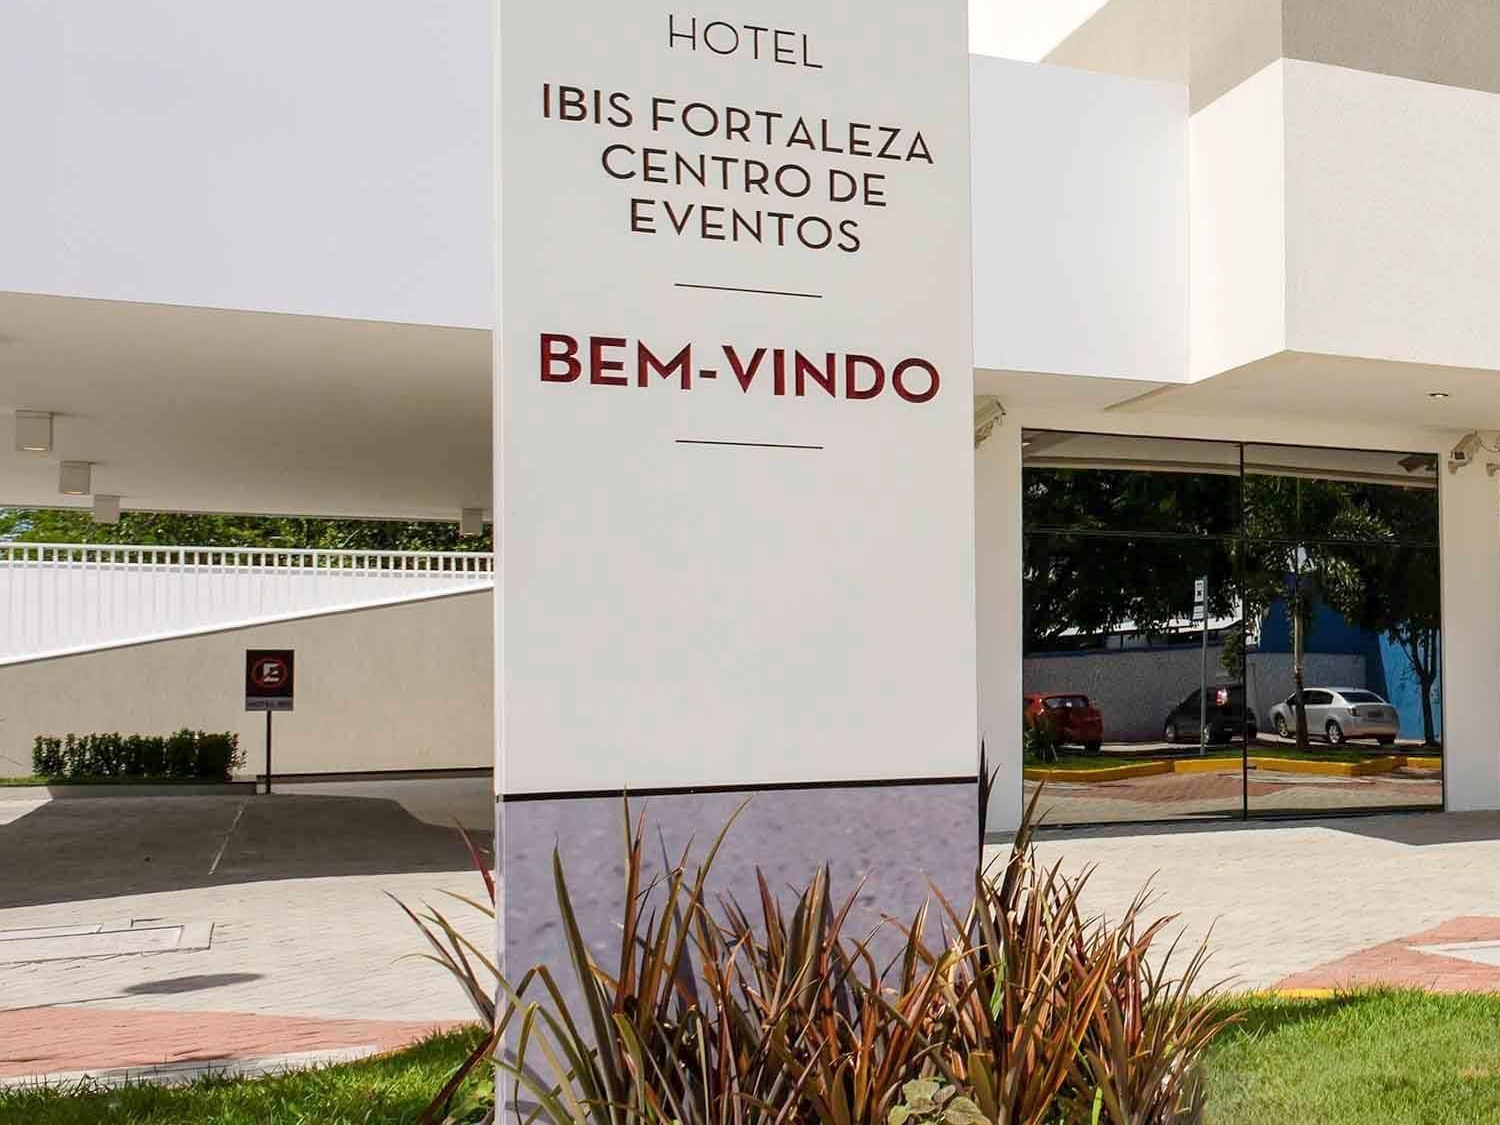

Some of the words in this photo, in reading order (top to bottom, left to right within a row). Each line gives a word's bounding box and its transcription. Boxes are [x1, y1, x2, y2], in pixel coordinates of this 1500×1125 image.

[668, 13, 824, 69] HOTEL
[542, 83, 634, 128] IBIS
[651, 96, 935, 165] FORTALEZA
[601, 144, 812, 198] CENTRO
[828, 168, 888, 207] DE
[630, 197, 861, 254] EVENTOS
[539, 332, 941, 404] BEM-VINDO
